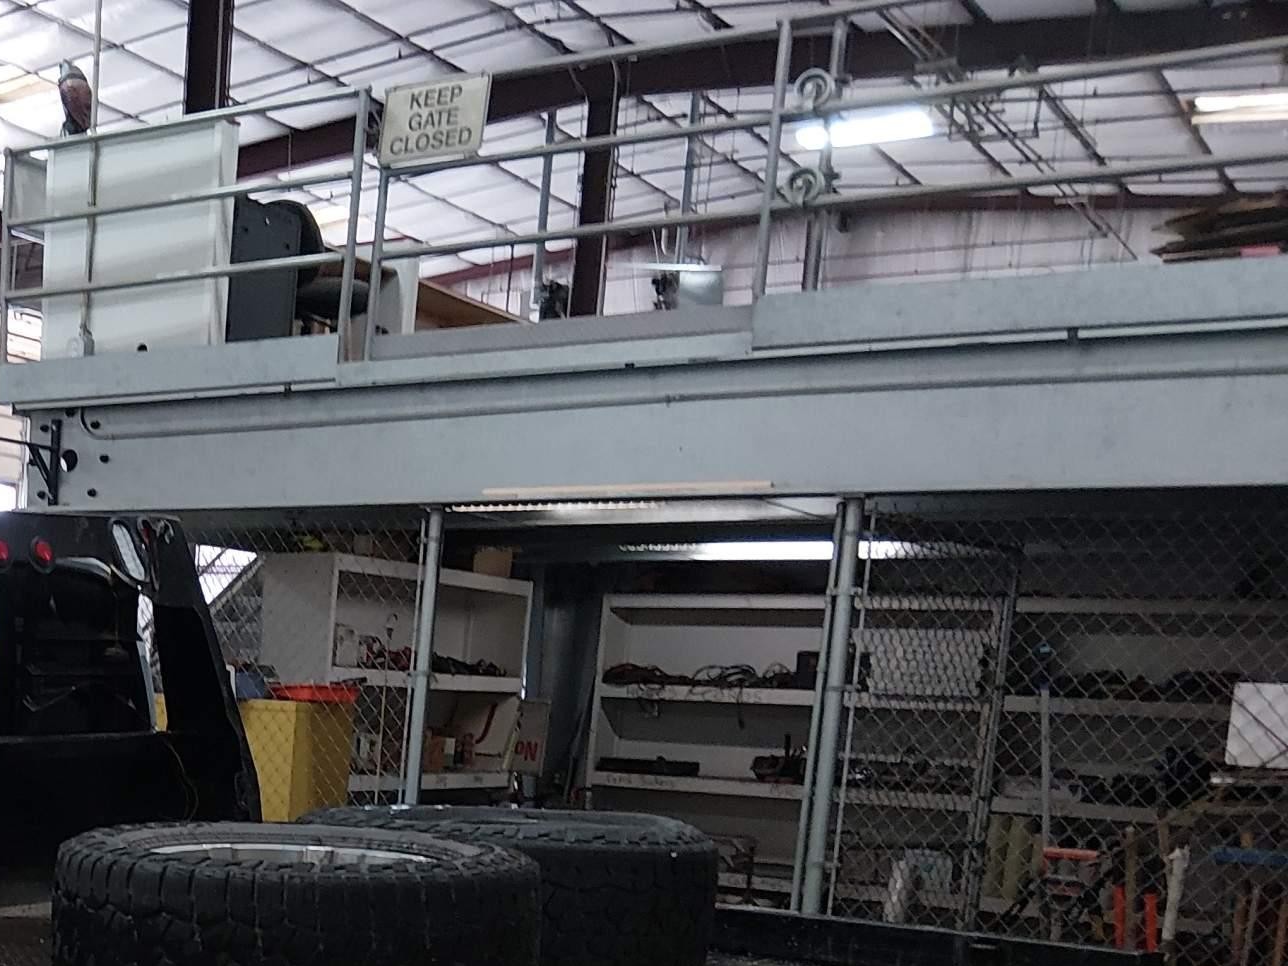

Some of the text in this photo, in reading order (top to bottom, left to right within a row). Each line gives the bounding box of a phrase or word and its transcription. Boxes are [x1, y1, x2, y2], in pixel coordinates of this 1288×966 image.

[410, 84, 463, 110] KEEP
[408, 105, 459, 132] GATE
[390, 126, 472, 156] CLOSED
